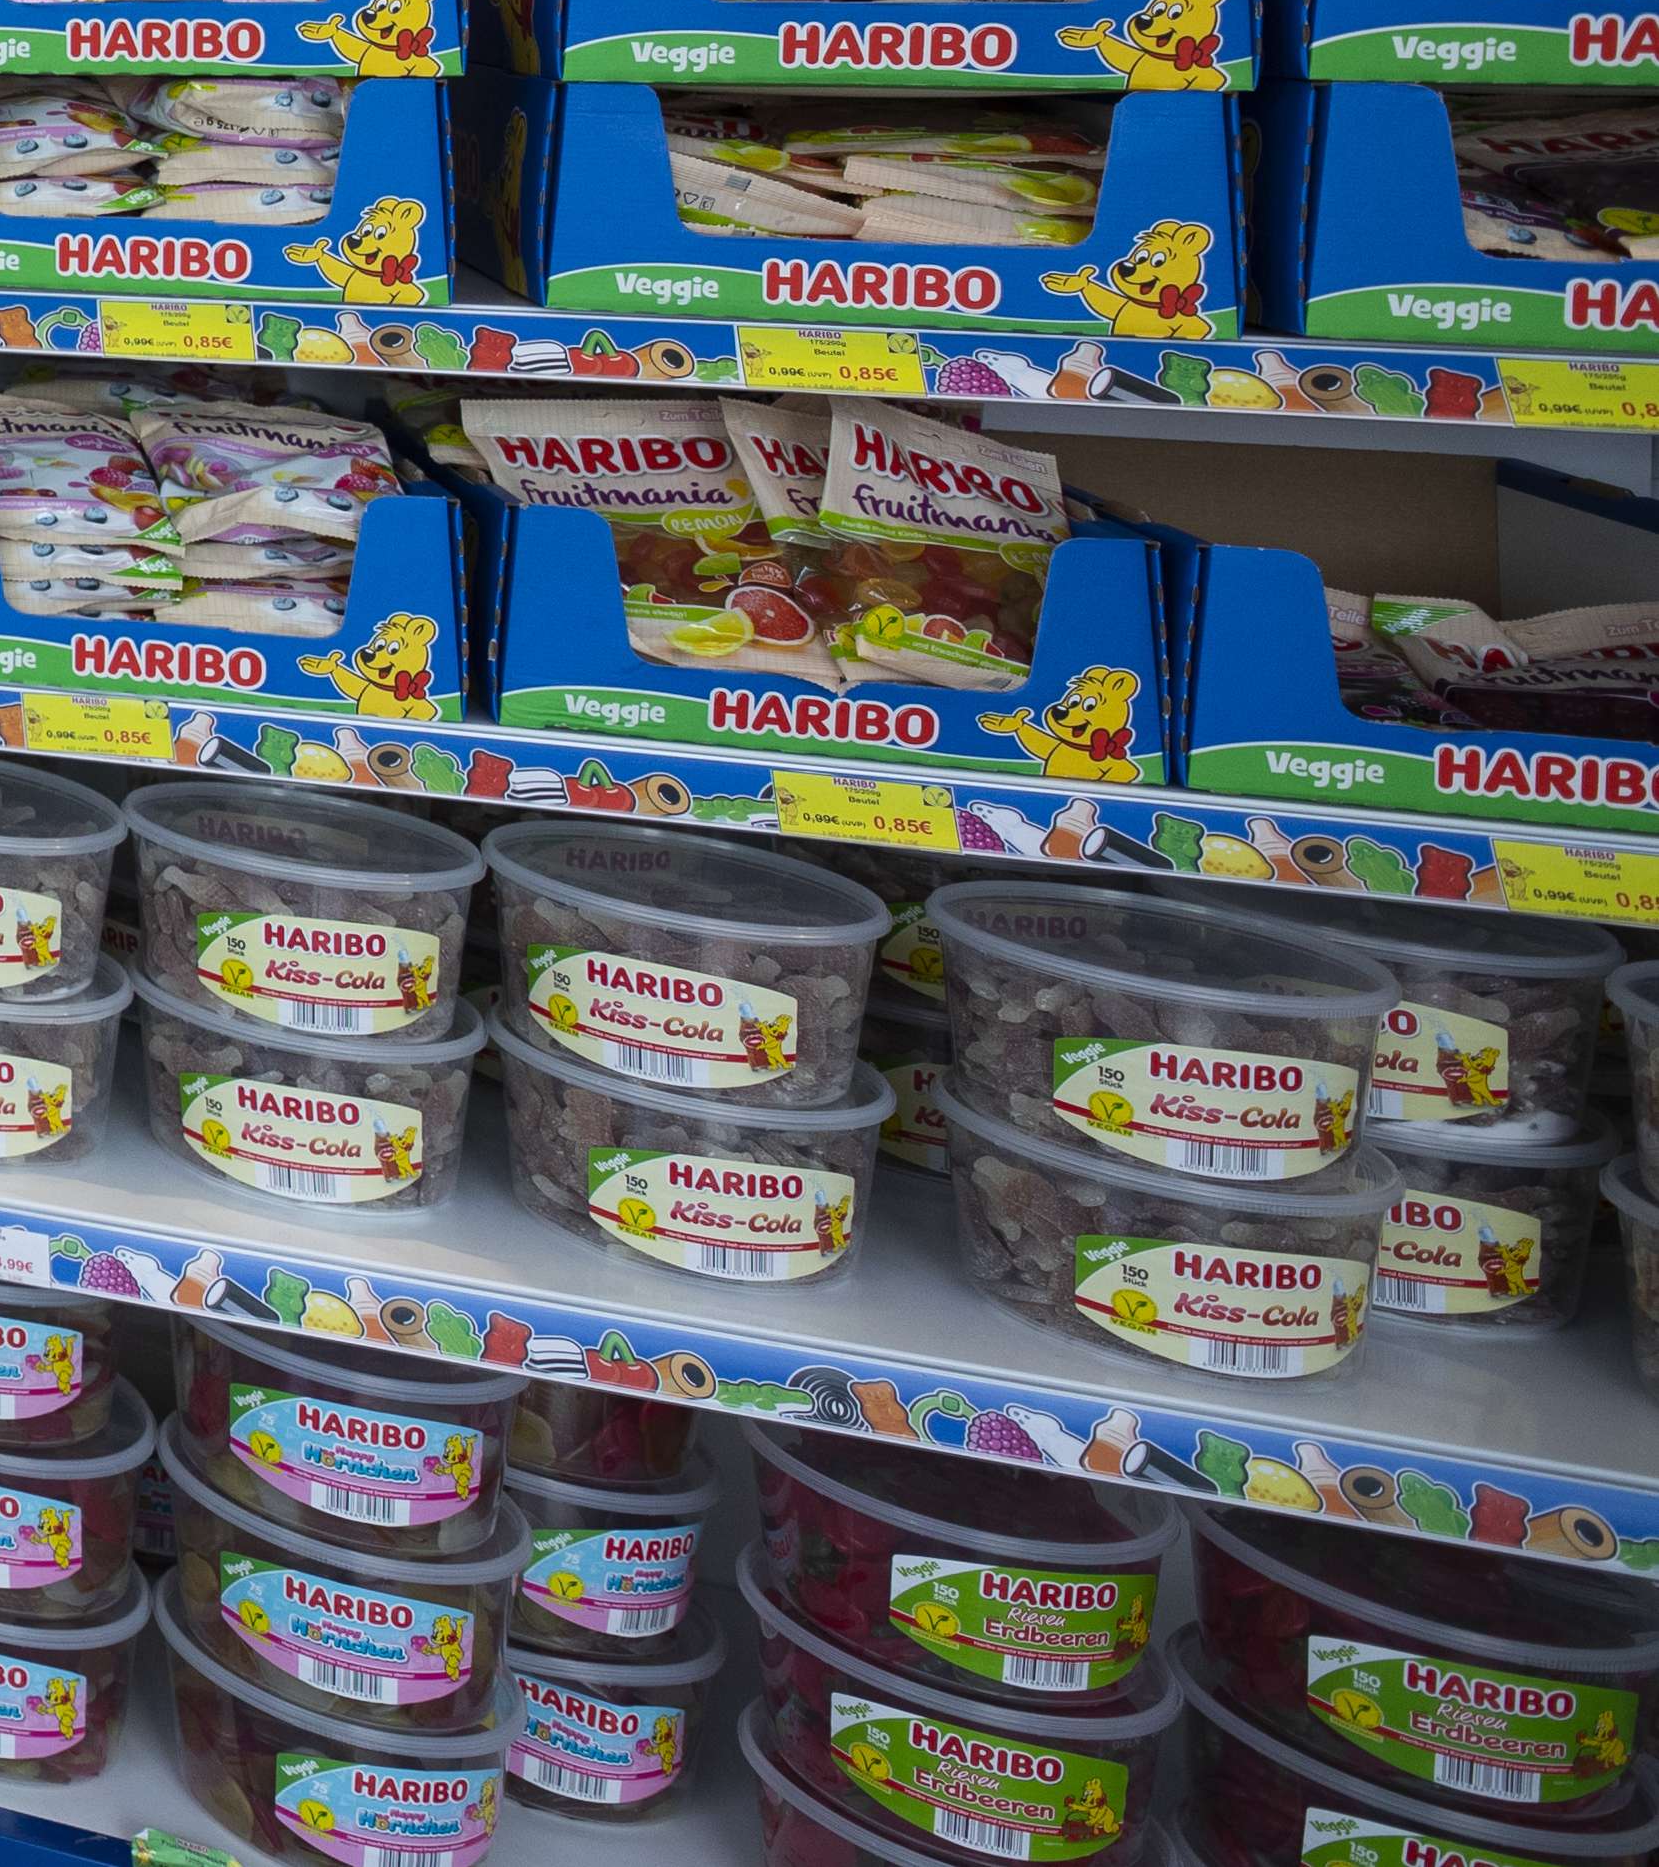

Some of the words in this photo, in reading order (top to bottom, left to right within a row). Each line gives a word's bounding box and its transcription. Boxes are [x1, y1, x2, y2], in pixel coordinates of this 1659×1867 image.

[67, 20, 263, 60] HARIBO
[631, 40, 736, 73] Veggie
[779, 23, 1015, 69] HARIBO
[1392, 36, 1516, 69] Veggie
[56, 236, 250, 279] HARIBO
[615, 273, 719, 305] Veggie
[763, 260, 999, 308] HARIBO
[1388, 294, 1511, 329] Veggie
[124, 337, 153, 346] 0,99€
[184, 336, 233, 349] 0,85€
[799, 331, 842, 339] HARIBO
[769, 367, 805, 376] 0,99€
[839, 367, 898, 381] 0,85€
[1539, 403, 1581, 414] 0,99€
[494, 436, 727, 474] HARIBO
[854, 423, 1045, 514] HARIBO
[521, 479, 733, 506] fruitmania
[73, 636, 263, 684] HARIBO
[565, 694, 665, 727] Veggie
[710, 691, 935, 745] HARIBO
[104, 730, 152, 744] 0,85€
[833, 778, 877, 788] HARIBO
[1265, 751, 1384, 789] Veggie
[848, 796, 879, 805] Beutel
[803, 813, 840, 824] 0,99€
[842, 819, 865, 828] (UVP)
[874, 816, 932, 835] 0,85€
[1584, 871, 1620, 881] Beutel
[1533, 889, 1576, 902] 0,99€
[225, 936, 246, 951] 150
[264, 923, 386, 958] HARIBO
[265, 960, 386, 992] Kiss-Cola
[552, 971, 571, 987] 150
[587, 960, 724, 1008] HARIBO
[589, 996, 725, 1044] Kiss-Cola
[1097, 1066, 1125, 1082] 150
[1099, 1077, 1123, 1089] Stück
[1149, 1051, 1303, 1092] HARIBO
[237, 1086, 360, 1126] HARIBO
[1149, 1093, 1301, 1129] Kiss-Cola
[241, 1123, 362, 1160] Kiss-Cola
[1086, 1119, 1133, 1137] VEGAN
[624, 1174, 648, 1191] 150
[668, 1162, 803, 1200] HARIBO
[618, 1227, 657, 1240] VEGAN
[670, 1200, 802, 1234] Kiss-Cola
[1121, 1263, 1149, 1281] 150
[1173, 1251, 1321, 1290] HARIBO
[1173, 1292, 1319, 1328] Kiss-Cola
[1109, 1320, 1157, 1337] VEGAN
[297, 1404, 426, 1451] HARIBO
[304, 1443, 420, 1482] Hörnchen
[605, 1533, 695, 1561] HARIBO
[285, 1577, 413, 1627] HARIBO
[933, 1582, 959, 1599] 150
[982, 1572, 1118, 1610] HARIBO
[985, 1618, 1110, 1647] Erdbeeren
[1007, 1607, 1065, 1627] Riesen
[290, 1616, 406, 1662] Hörnchen
[1351, 1668, 1380, 1688] 150
[1405, 1662, 1576, 1720] HARIBO
[1437, 1704, 1507, 1732] Riesen
[1410, 1712, 1566, 1758] Erdbeeren
[910, 1722, 1062, 1782] HARIBO
[353, 1772, 469, 1804] HARIBO
[937, 1758, 1001, 1791] Riesen
[916, 1768, 1056, 1820] Erdbeeren
[359, 1809, 461, 1835] Hörnchen
[1350, 1841, 1379, 1863] 150
